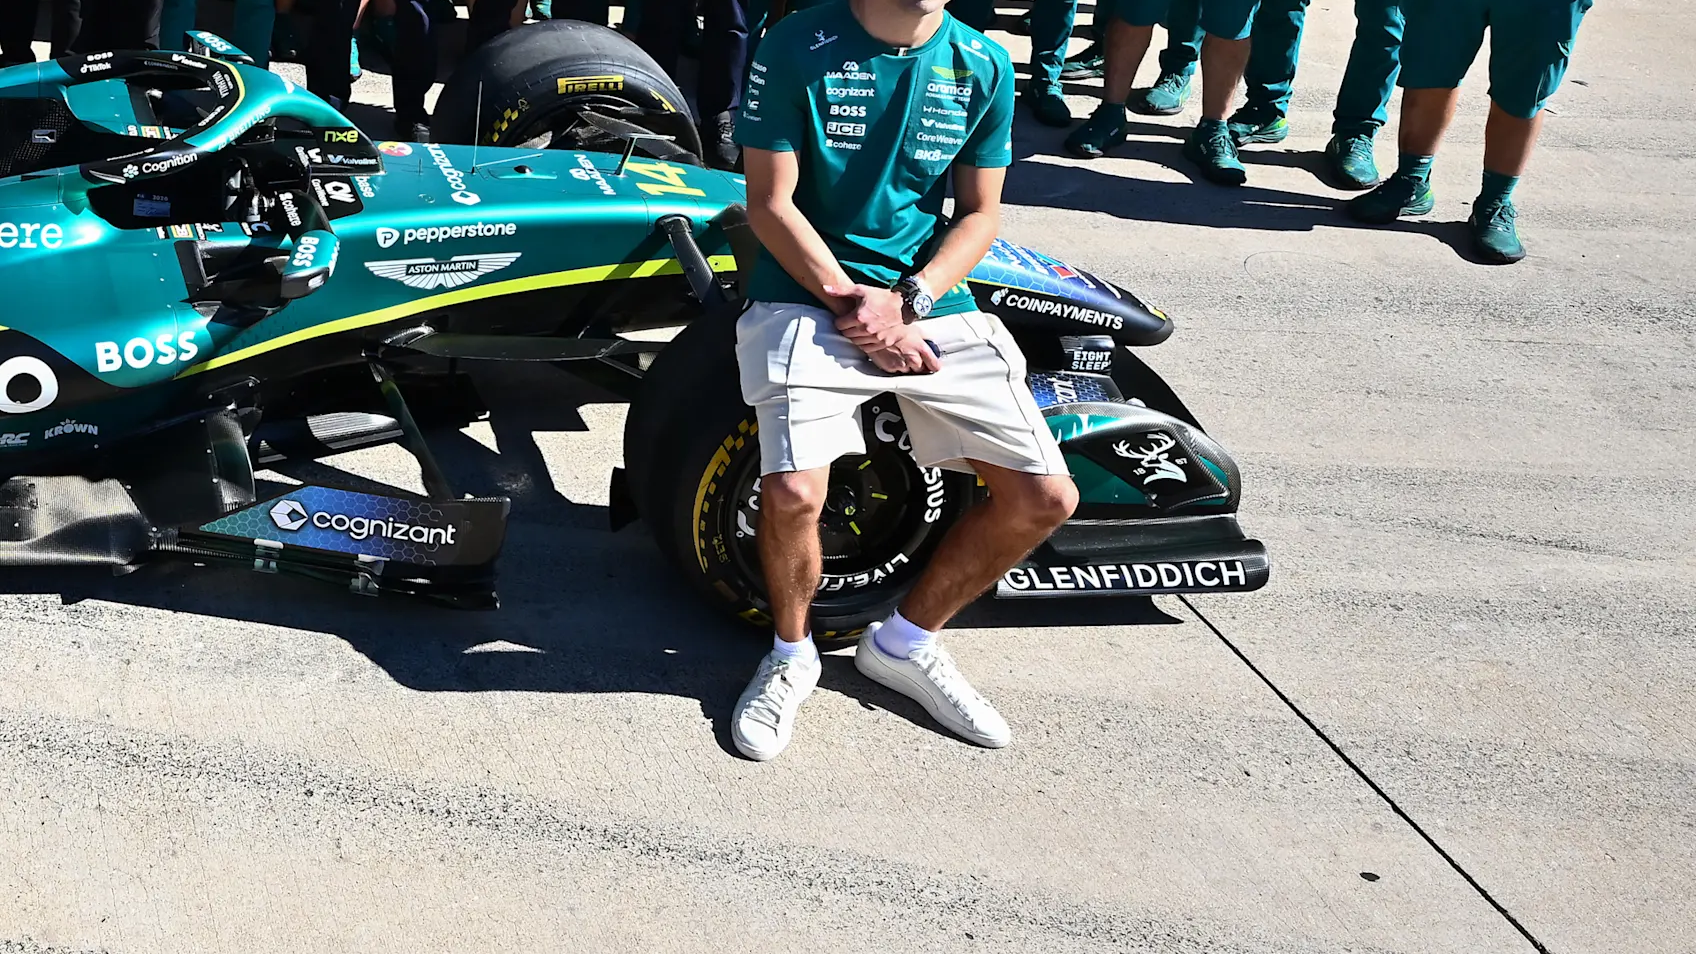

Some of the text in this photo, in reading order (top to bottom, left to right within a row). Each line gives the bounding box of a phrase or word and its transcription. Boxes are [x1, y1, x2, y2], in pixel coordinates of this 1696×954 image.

[196, 32, 232, 52] BOSS
[826, 71, 876, 81] MAADEN
[557, 76, 624, 94] PIRELLI
[826, 86, 875, 98] cognizant
[927, 83, 973, 96] aramco
[830, 105, 866, 117] BOSS
[933, 106, 968, 118] Honda
[829, 124, 863, 135] JCB
[833, 141, 862, 150] cohere
[916, 132, 963, 146] CoreWeave
[914, 149, 941, 161] BK8
[142, 152, 198, 174] Cognition
[423, 143, 466, 190] cognizant
[573, 154, 617, 196] MAADEN
[627, 161, 707, 197] 14
[403, 221, 517, 245] pepperstone
[293, 236, 320, 268] BOSS
[407, 261, 477, 274] ASTON MARTIN
[1006, 293, 1123, 331] COINPAYMENTS
[95, 331, 198, 373] BOSS
[1073, 350, 1110, 361] EIGHT
[1071, 360, 1108, 371] SLEEP
[44, 422, 98, 439] KROWN
[1133, 467, 1147, 477] 18
[313, 510, 457, 545] cognizant
[1004, 561, 1246, 590] GLENFIDDICH
